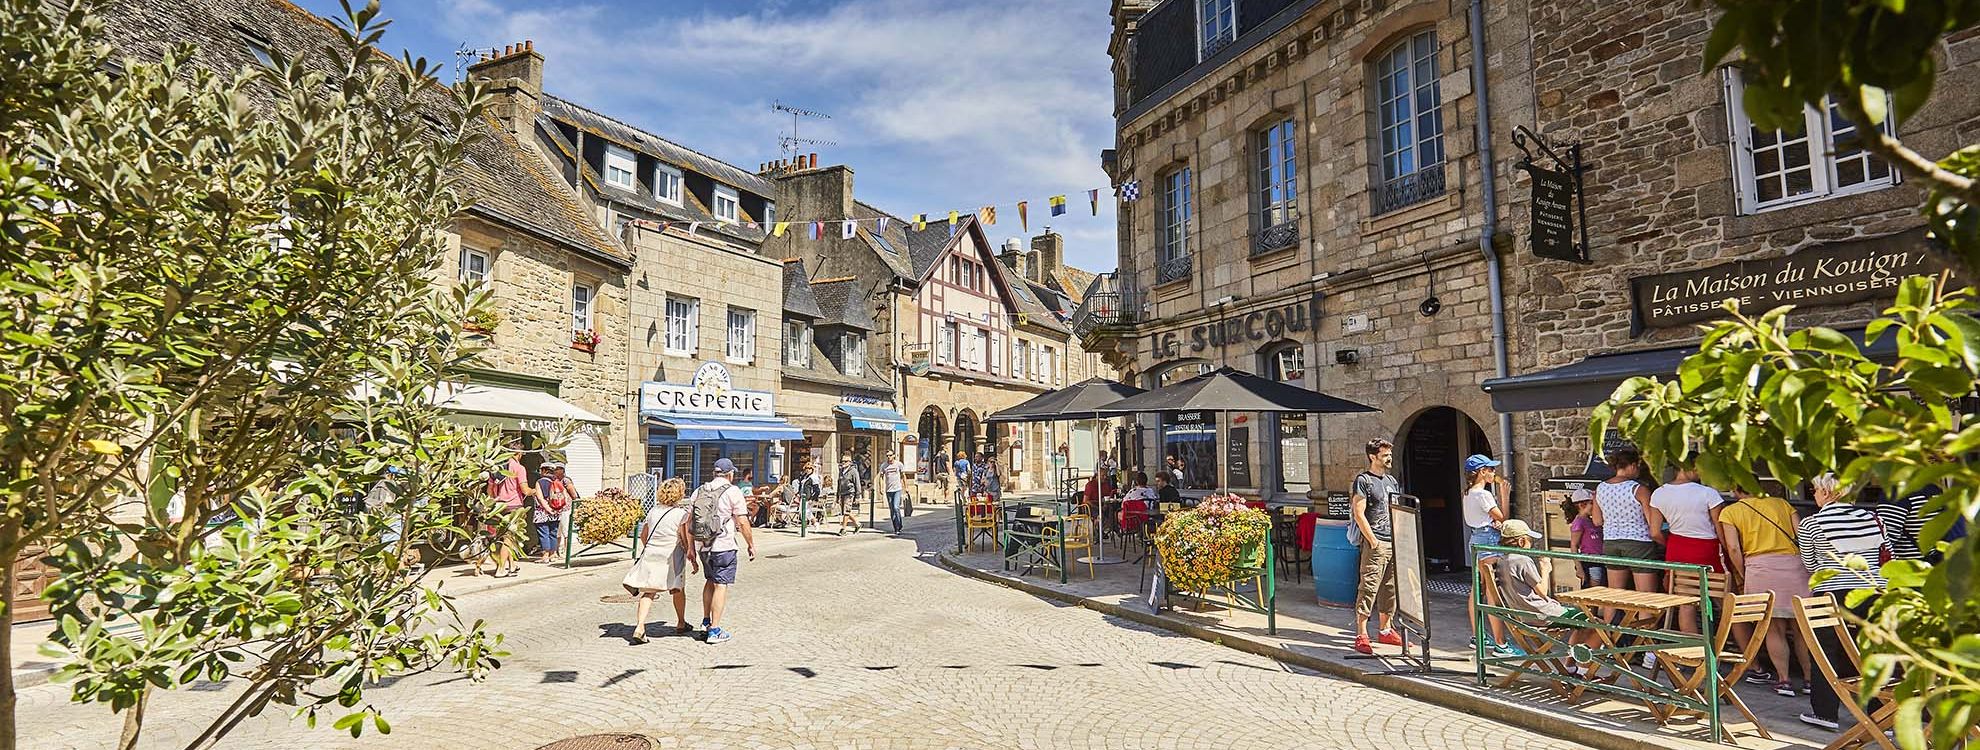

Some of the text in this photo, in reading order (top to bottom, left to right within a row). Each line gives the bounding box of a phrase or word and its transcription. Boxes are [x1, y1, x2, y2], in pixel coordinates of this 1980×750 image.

[1652, 285, 1678, 304] La
[1685, 272, 1767, 299] Maison
[1776, 260, 1805, 284] du
[1813, 250, 1908, 282] Kouign
[1652, 295, 1752, 318] PÂTISSEE
[1151, 331, 1178, 360] LE
[1175, 422, 1205, 431] RESTAURANT
[1177, 411, 1202, 422] BRASSERIE
